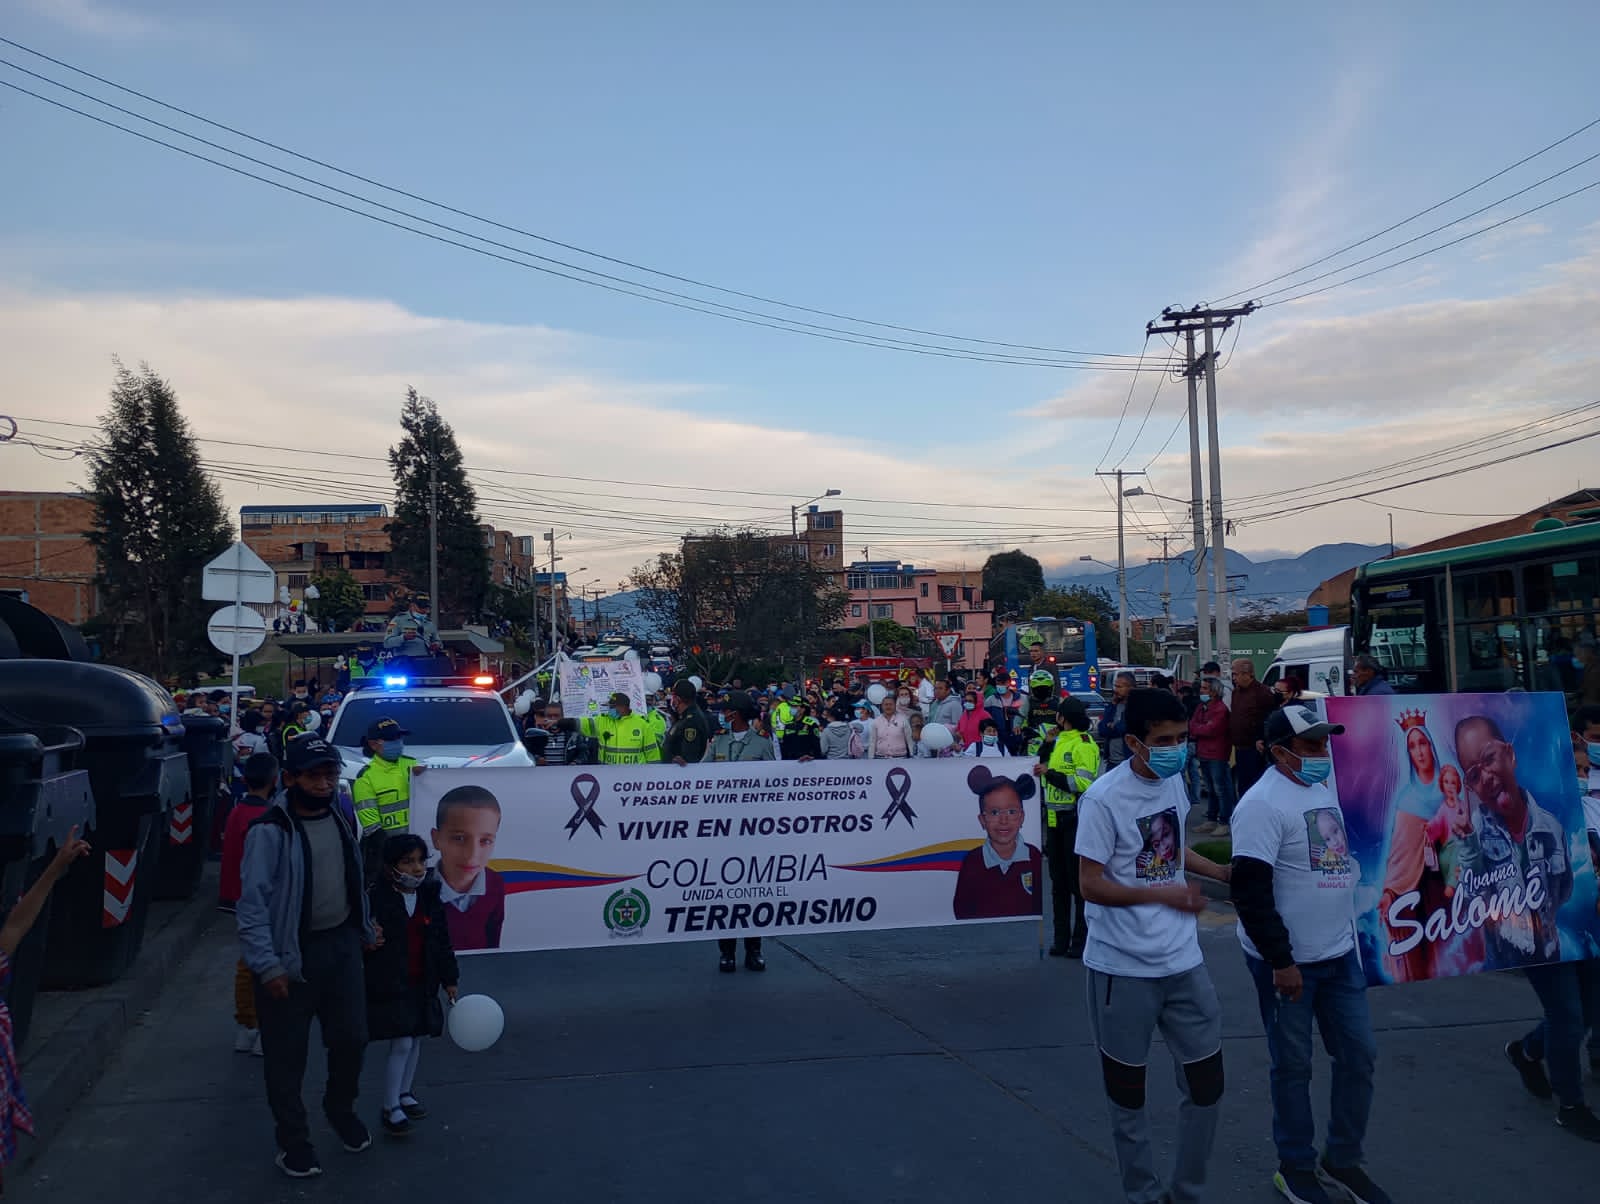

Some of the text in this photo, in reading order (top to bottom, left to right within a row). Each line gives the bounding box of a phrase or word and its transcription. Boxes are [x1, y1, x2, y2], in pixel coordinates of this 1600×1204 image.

[373, 696, 474, 705] POLICIA
[612, 775, 873, 793] CON DOLOR DE PATRIA LOS DESPEDIMOS
[620, 789, 868, 807] Y PASAN DE VIVIR ENTRE NOSOTROS A
[617, 813, 875, 841] VIVIR EN NOSOTROS
[646, 853, 828, 889] COLOMBIA
[1464, 863, 1517, 894] Ivanna
[682, 885, 789, 902] UNIDA CONTRA EL
[664, 896, 878, 933] TERRORISMO
[1388, 865, 1545, 955] Salomé
